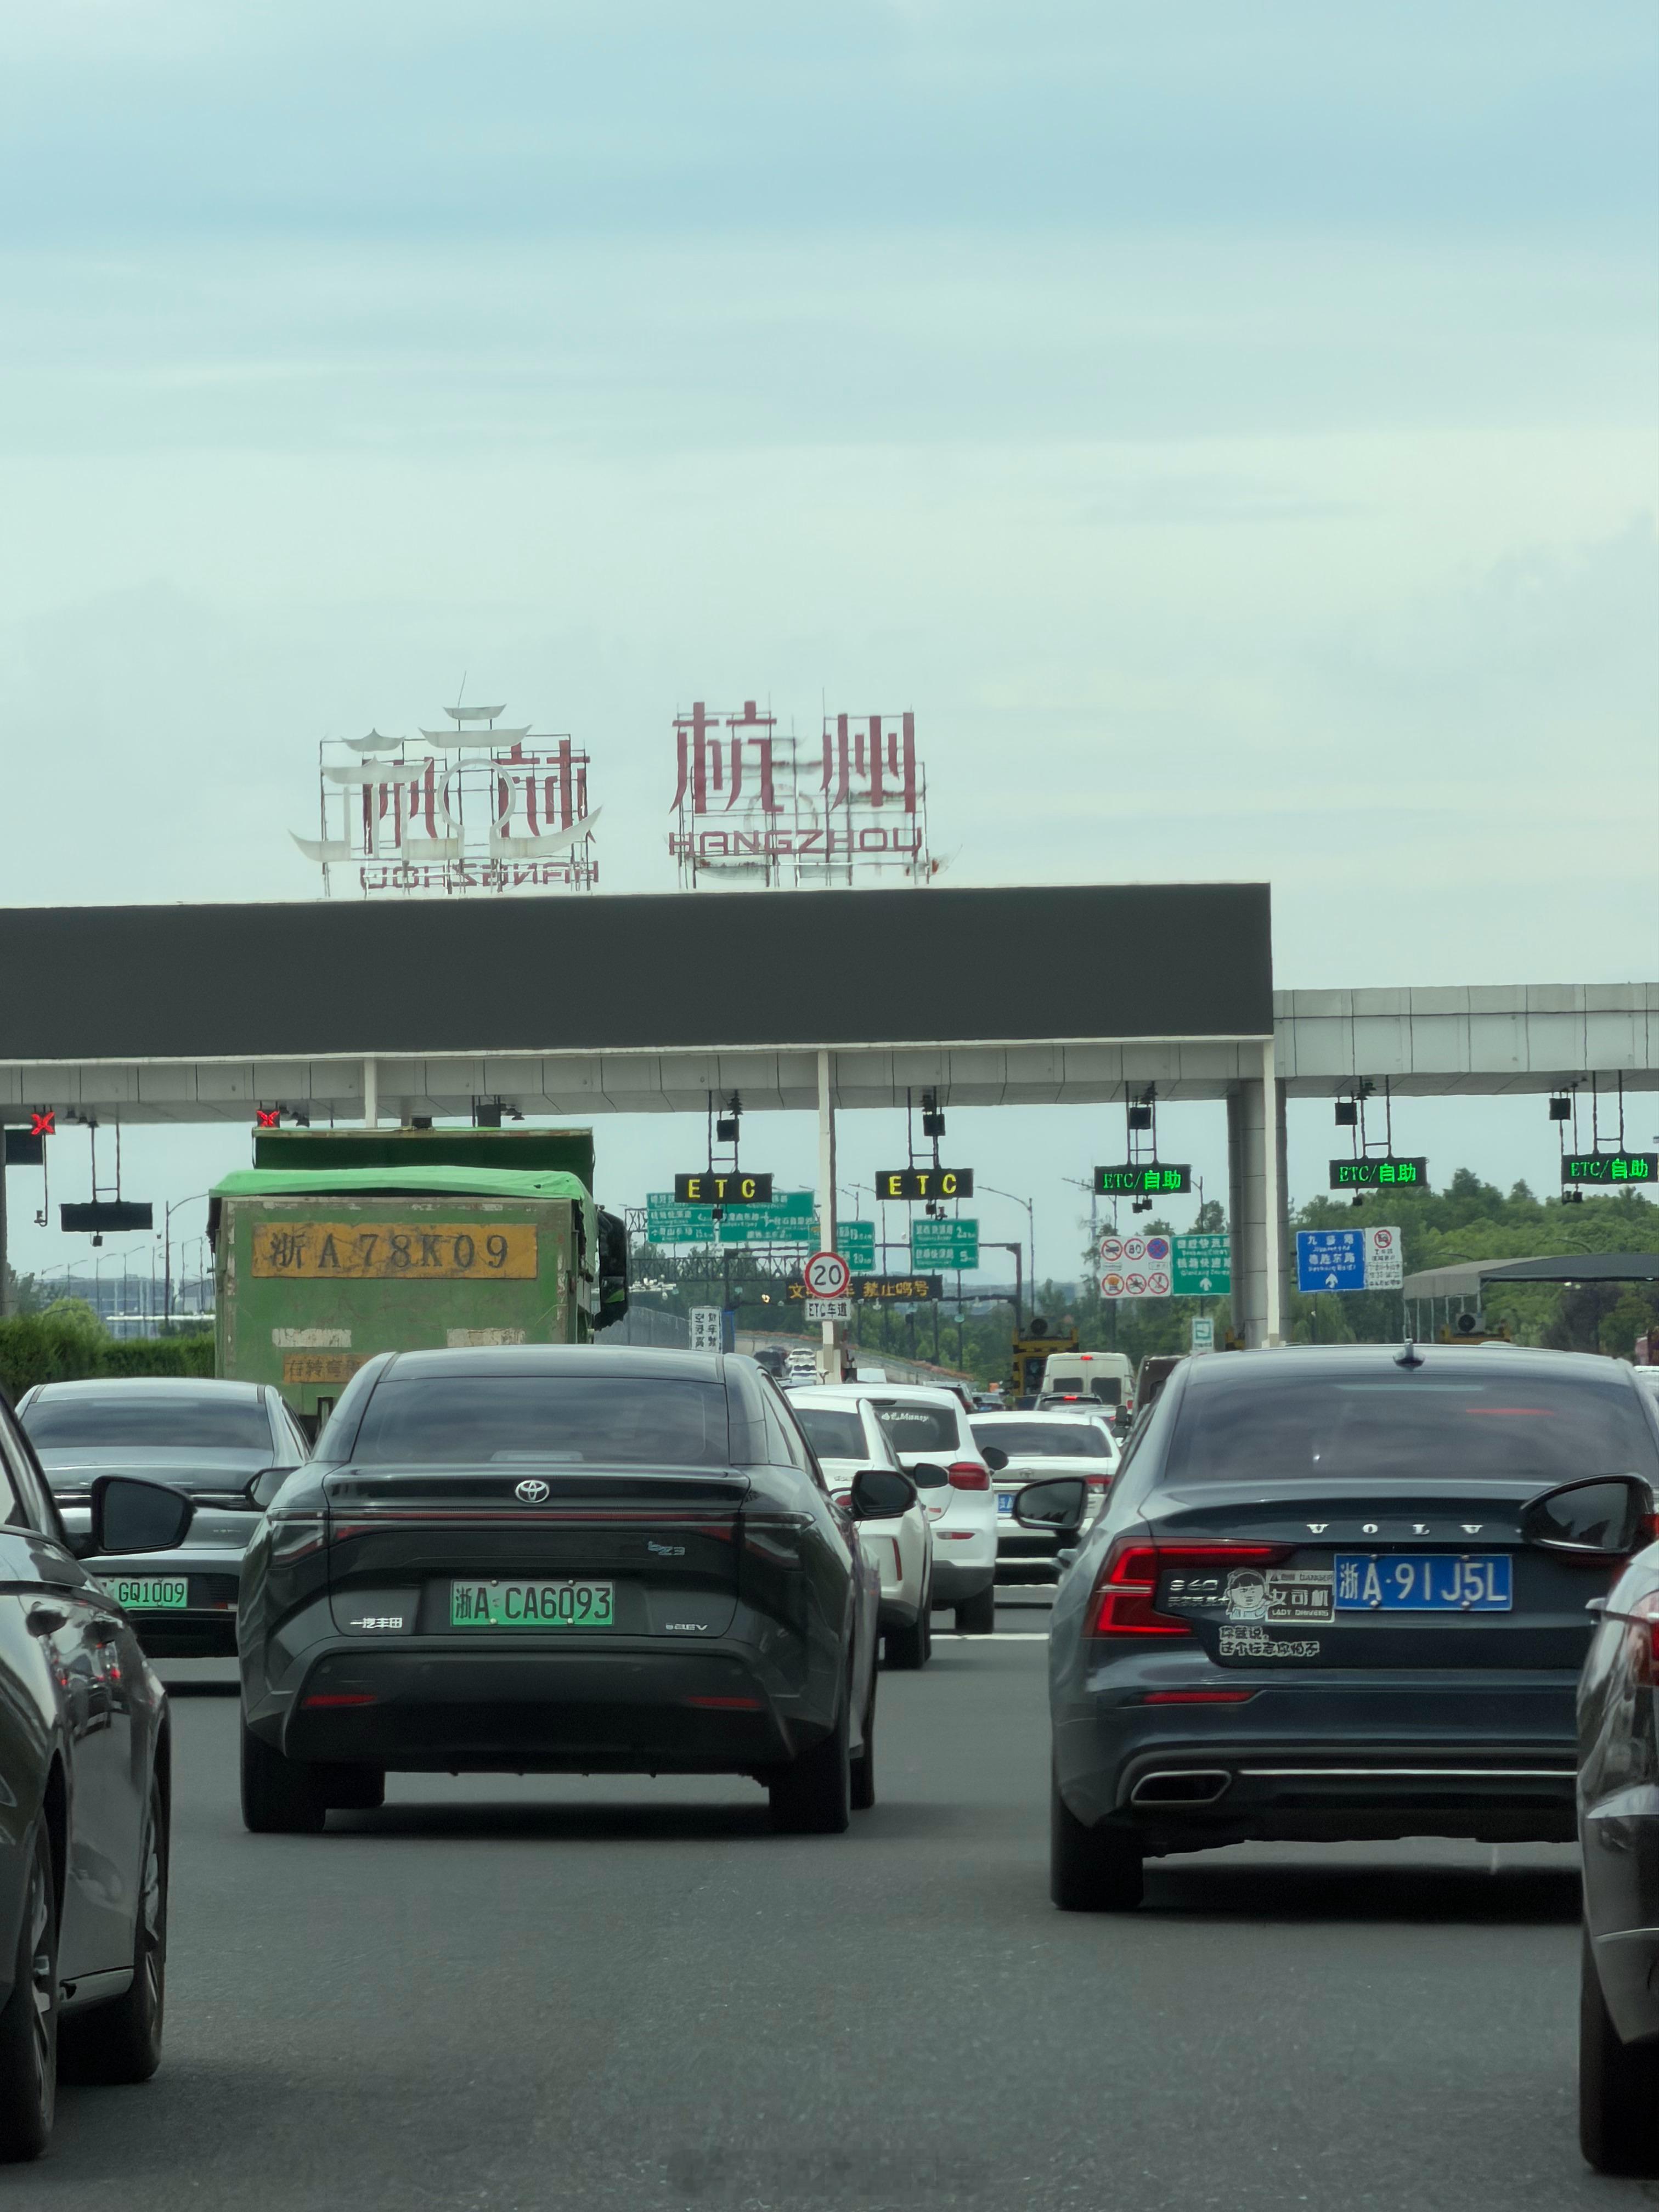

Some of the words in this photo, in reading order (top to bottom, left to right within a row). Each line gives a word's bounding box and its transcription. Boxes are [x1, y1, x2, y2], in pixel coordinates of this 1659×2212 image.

[669, 701, 916, 814] 杭州
[669, 827, 922, 856] HANGZHOU
[1339, 1163, 1416, 1183] ETC/自助
[1570, 1158, 1649, 1180] ETC/自助
[688, 1179, 755, 1199] ETC
[889, 1173, 957, 1195] ETC
[1103, 1170, 1181, 1190] ETC/自助
[1128, 1244, 1142, 1254] 80
[814, 1265, 842, 1285] 20
[864, 1281, 929, 1297] 禁止鸣号
[809, 1302, 848, 1319] ETC车道
[1307, 1523, 1521, 1535] VOLV
[101, 1582, 185, 1603] GQ1009
[349, 1617, 403, 1629] 一汽丰田
